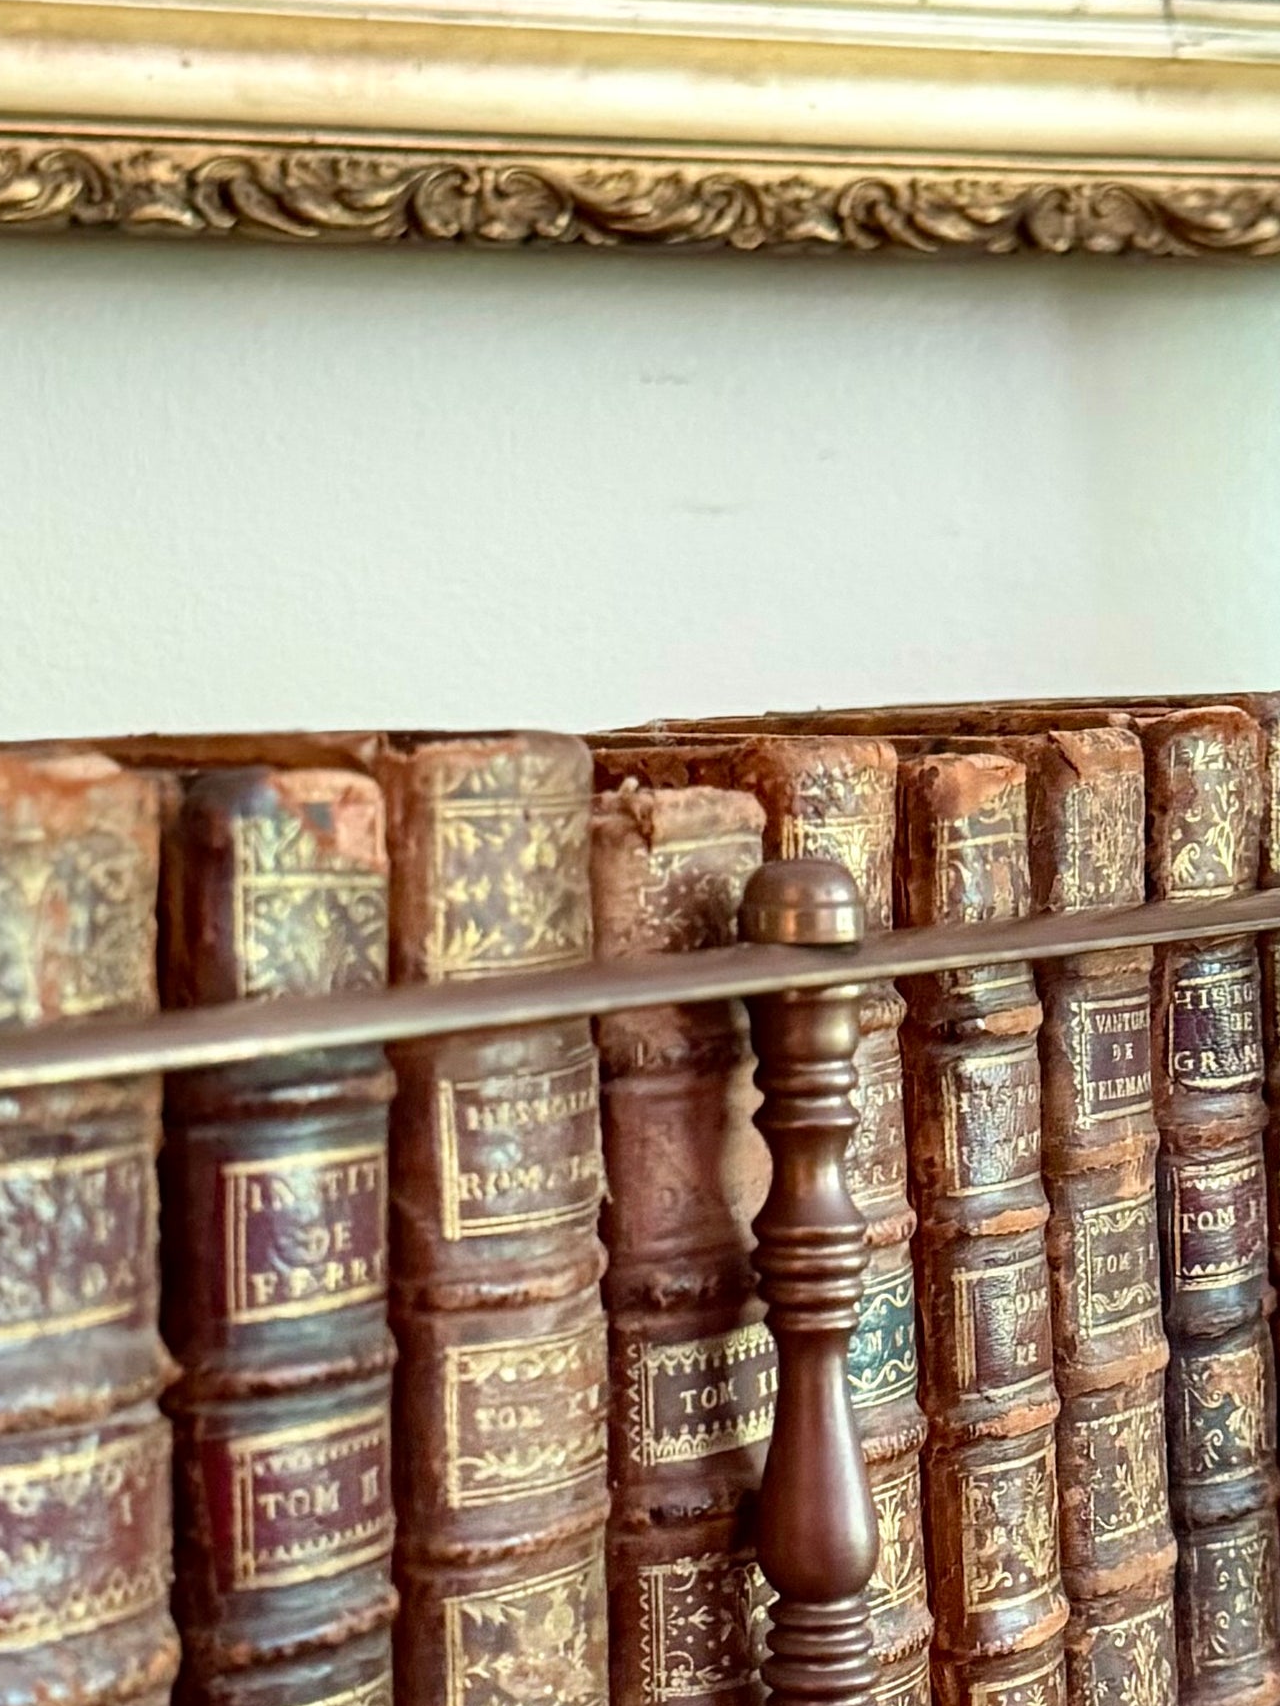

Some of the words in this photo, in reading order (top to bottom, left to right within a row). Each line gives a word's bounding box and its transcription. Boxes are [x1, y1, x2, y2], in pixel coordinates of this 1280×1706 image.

[1174, 982, 1253, 1010] HISTO
[1231, 1011, 1253, 1031] DE
[1111, 1042, 1134, 1062] DE
[1174, 1043, 1258, 1072] GRAN
[250, 1163, 376, 1213] INTIT
[1182, 1205, 1237, 1233] TOM
[306, 1221, 352, 1262] DE
[1093, 1251, 1131, 1275] TOM
[680, 1377, 738, 1414] TOM
[475, 1405, 544, 1432] TOM
[257, 1480, 340, 1521] TOM
